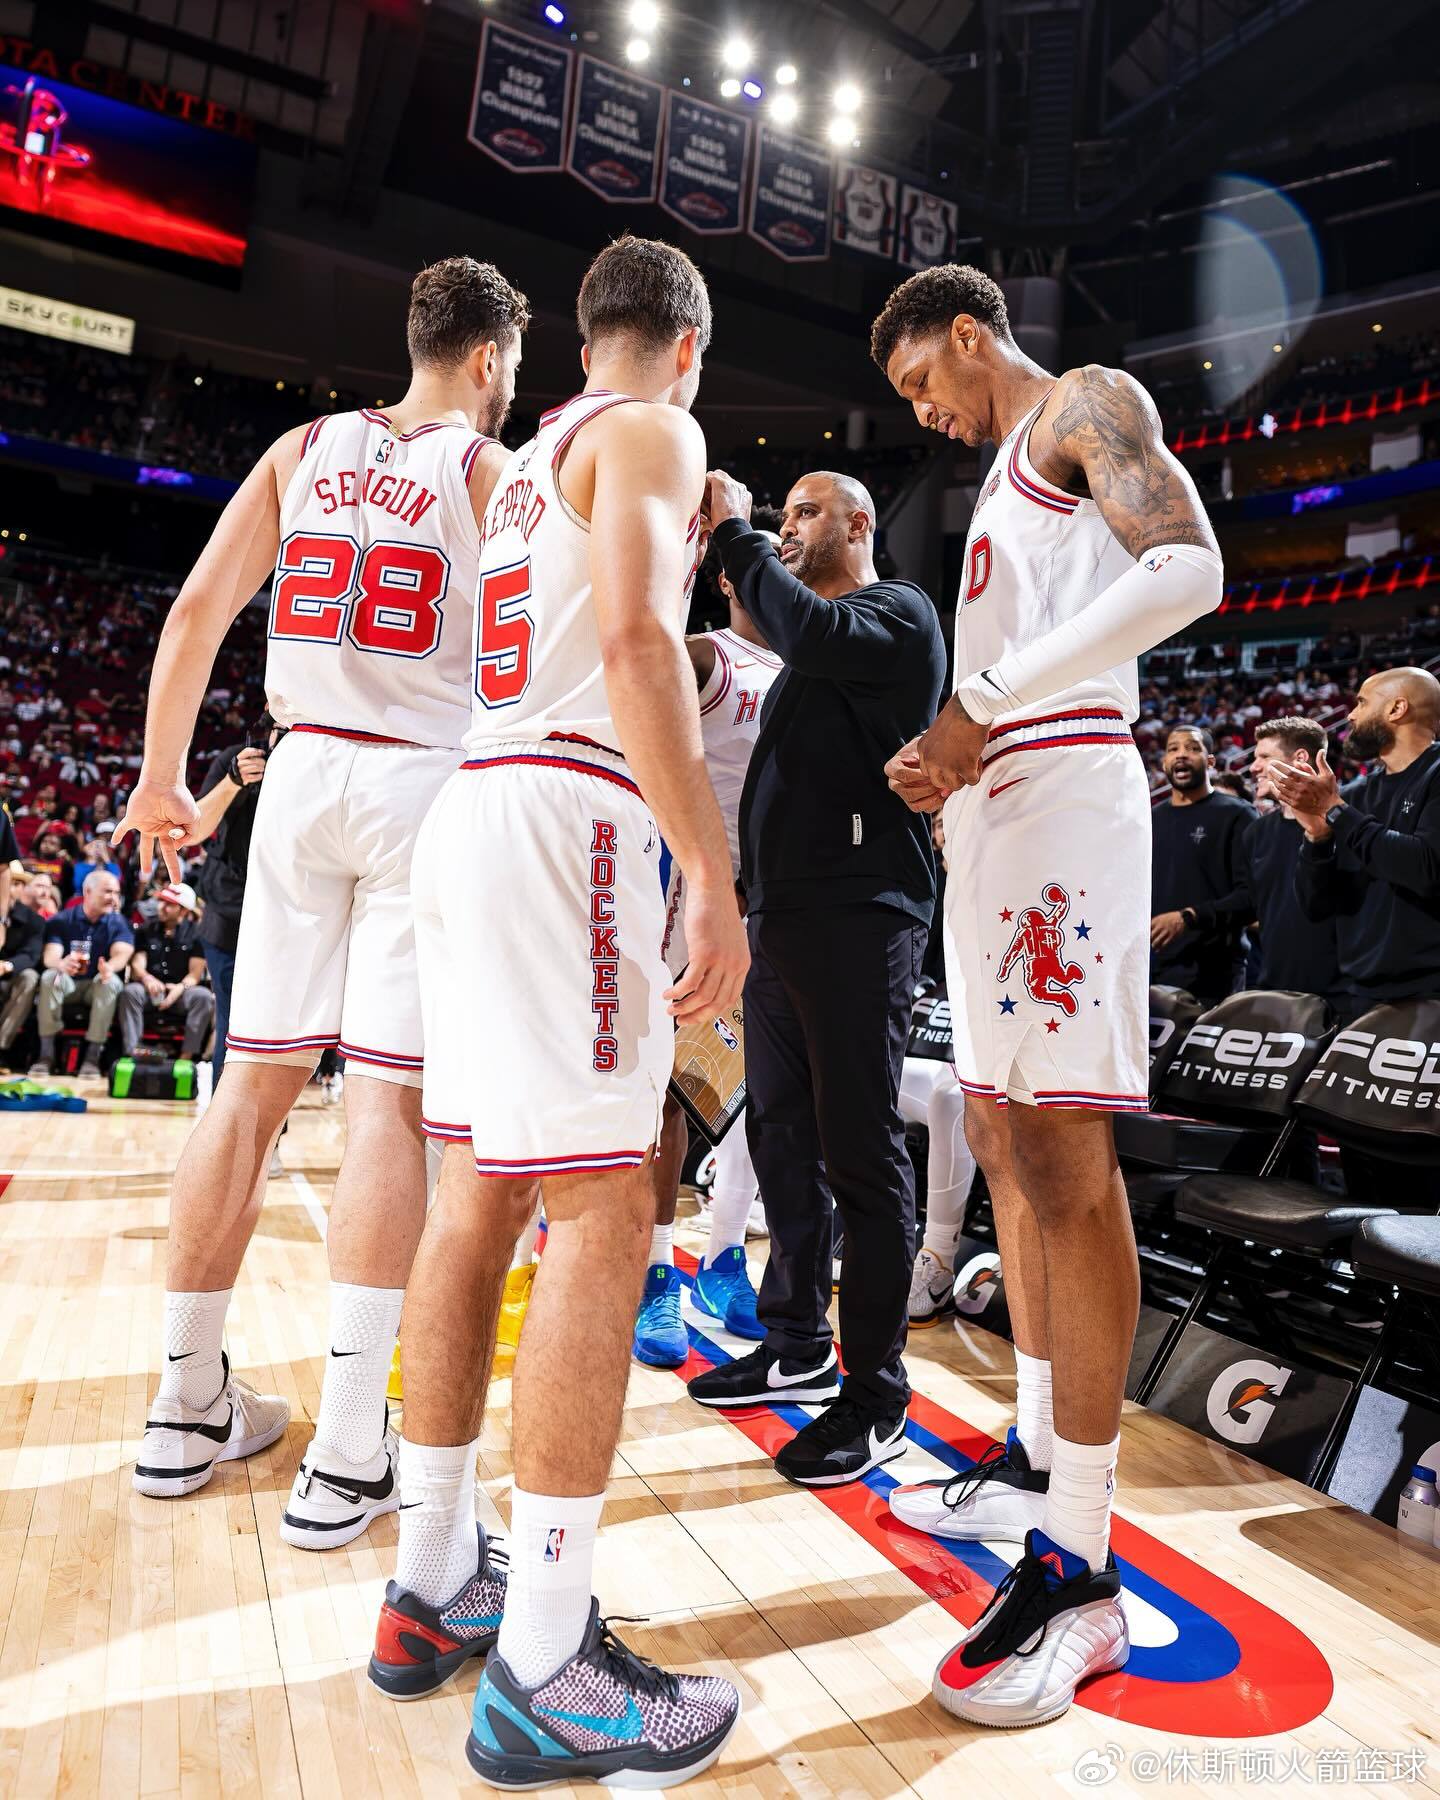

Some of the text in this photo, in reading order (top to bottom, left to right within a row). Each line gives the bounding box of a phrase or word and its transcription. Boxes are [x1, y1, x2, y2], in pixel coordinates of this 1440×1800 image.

[314, 468, 438, 528] SENGUN
[268, 530, 451, 660] 28
[475, 554, 535, 710] 5
[589, 818, 620, 1074] ROCKETS
[1167, 1061, 1289, 1090] FITNESS
[1206, 1358, 1294, 1444] G
